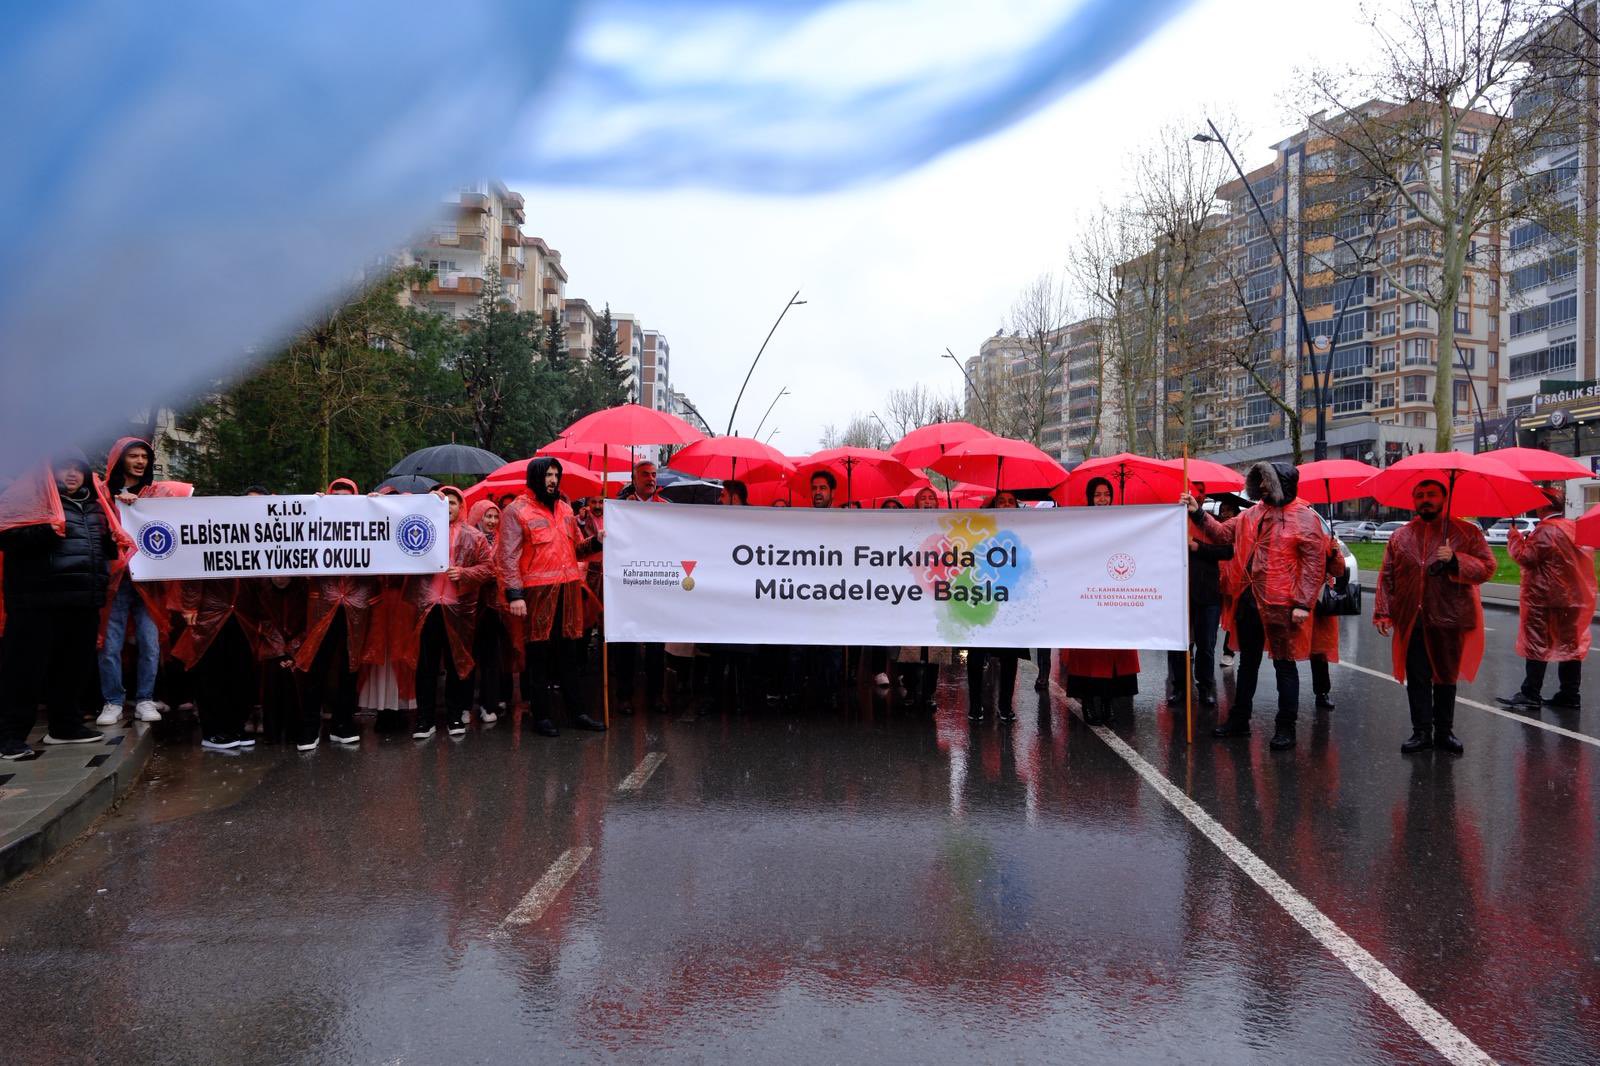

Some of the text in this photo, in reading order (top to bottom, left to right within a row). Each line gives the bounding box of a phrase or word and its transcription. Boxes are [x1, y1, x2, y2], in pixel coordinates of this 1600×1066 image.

[1544, 388, 1584, 404] SAĞLIK
[267, 501, 306, 516] K.İ.Ü.
[180, 519, 250, 545] ELBİSTAN
[255, 518, 304, 543] SAĞLIK
[309, 516, 390, 541] HİZMETLERİ
[203, 545, 371, 572] MESLEK YÜKSEK OKULU
[732, 544, 1017, 568] Otizmin Farkında Ol
[622, 578, 680, 586] Büyükşehir Belediyesi
[623, 569, 680, 578] Kahramanmaraş
[755, 579, 1009, 606] Mücadeleye Başla
